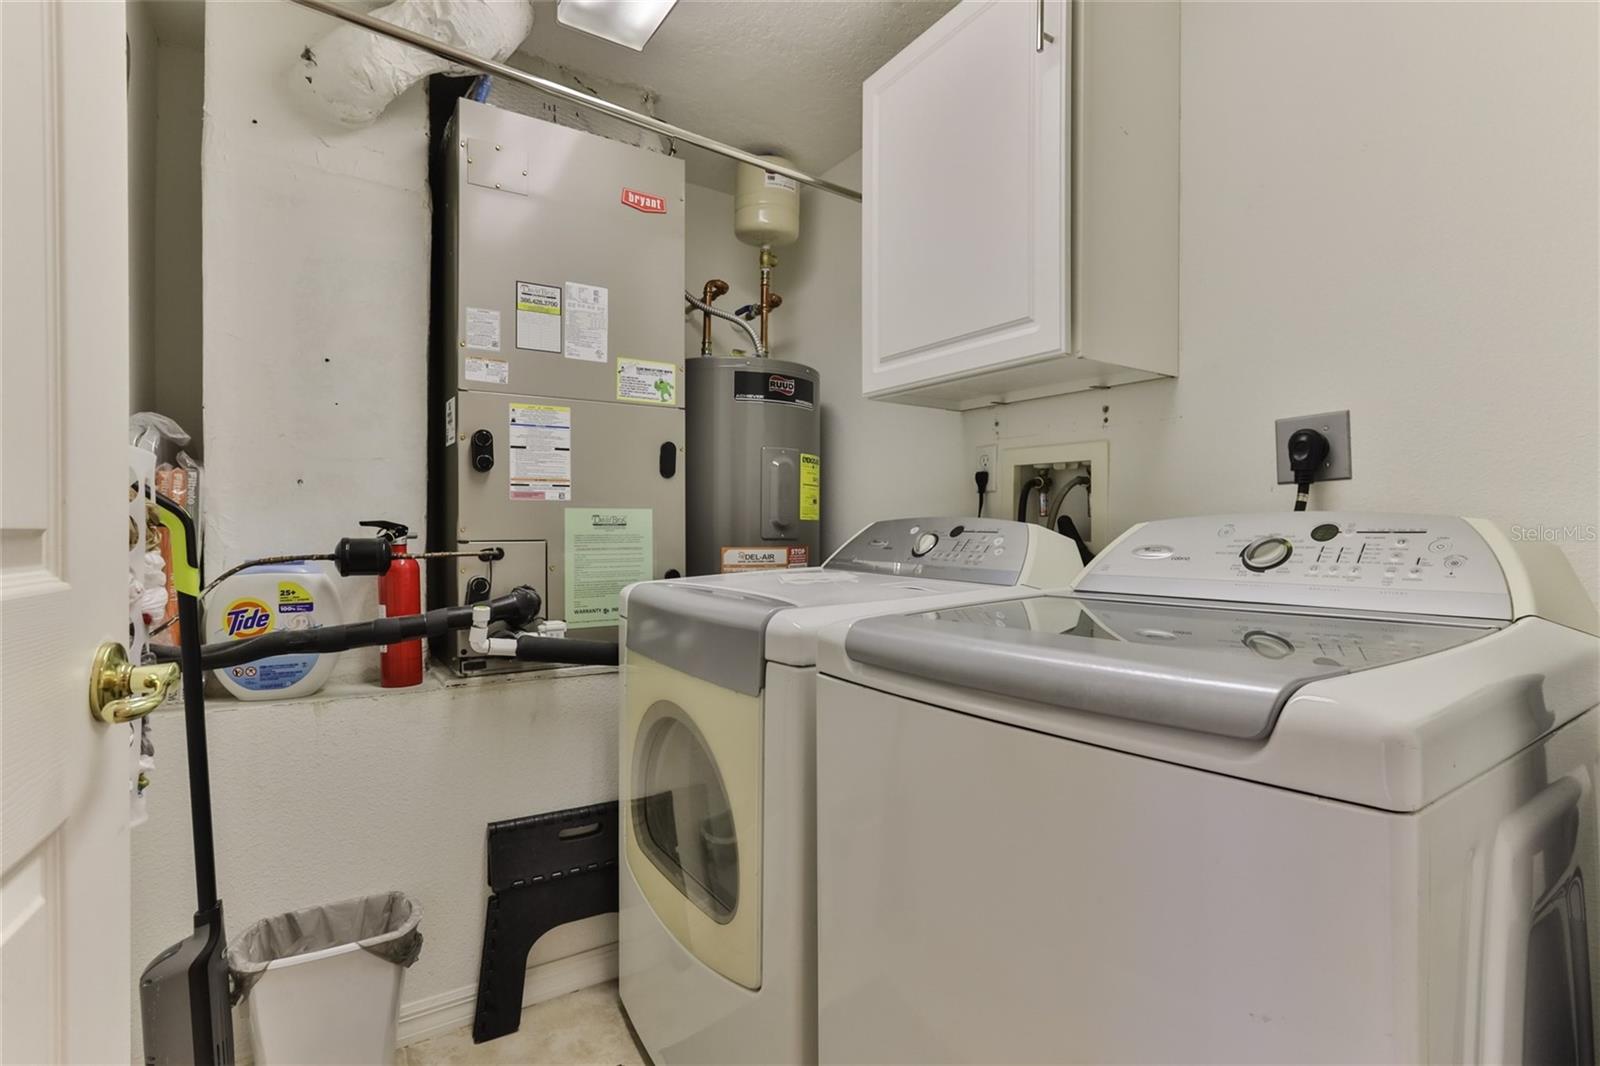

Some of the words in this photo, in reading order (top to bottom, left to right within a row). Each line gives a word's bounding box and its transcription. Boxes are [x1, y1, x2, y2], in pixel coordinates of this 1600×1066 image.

[628, 191, 661, 209] bryant
[769, 380, 794, 390] RUUD
[227, 608, 270, 636] Tide
